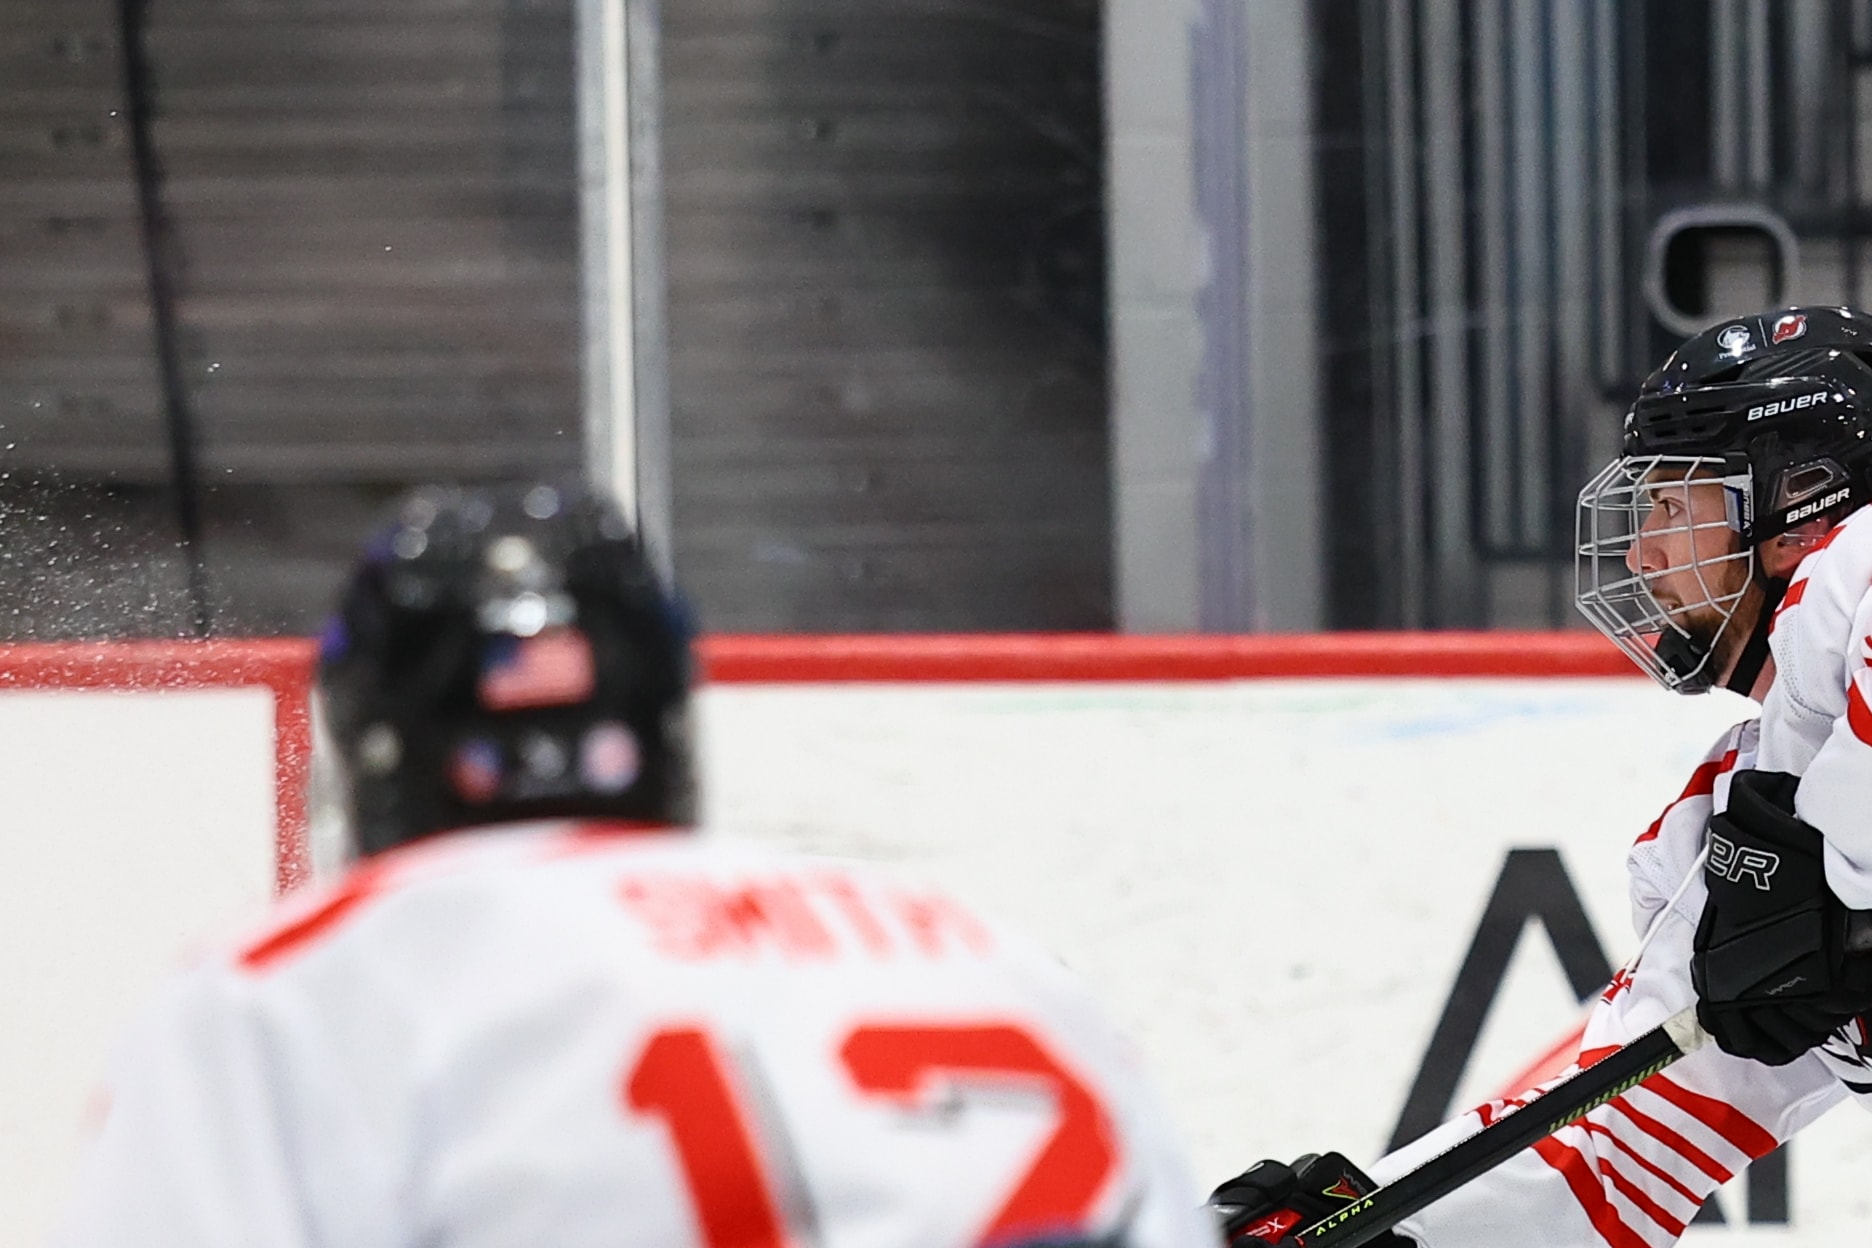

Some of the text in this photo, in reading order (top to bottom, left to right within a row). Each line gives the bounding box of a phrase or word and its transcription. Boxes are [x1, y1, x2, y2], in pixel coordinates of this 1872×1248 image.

[1747, 392, 1828, 421] BAUER
[1786, 488, 1850, 524] BAUER
[615, 866, 995, 966] SMITH
[1316, 1199, 1374, 1237] ALPHA
